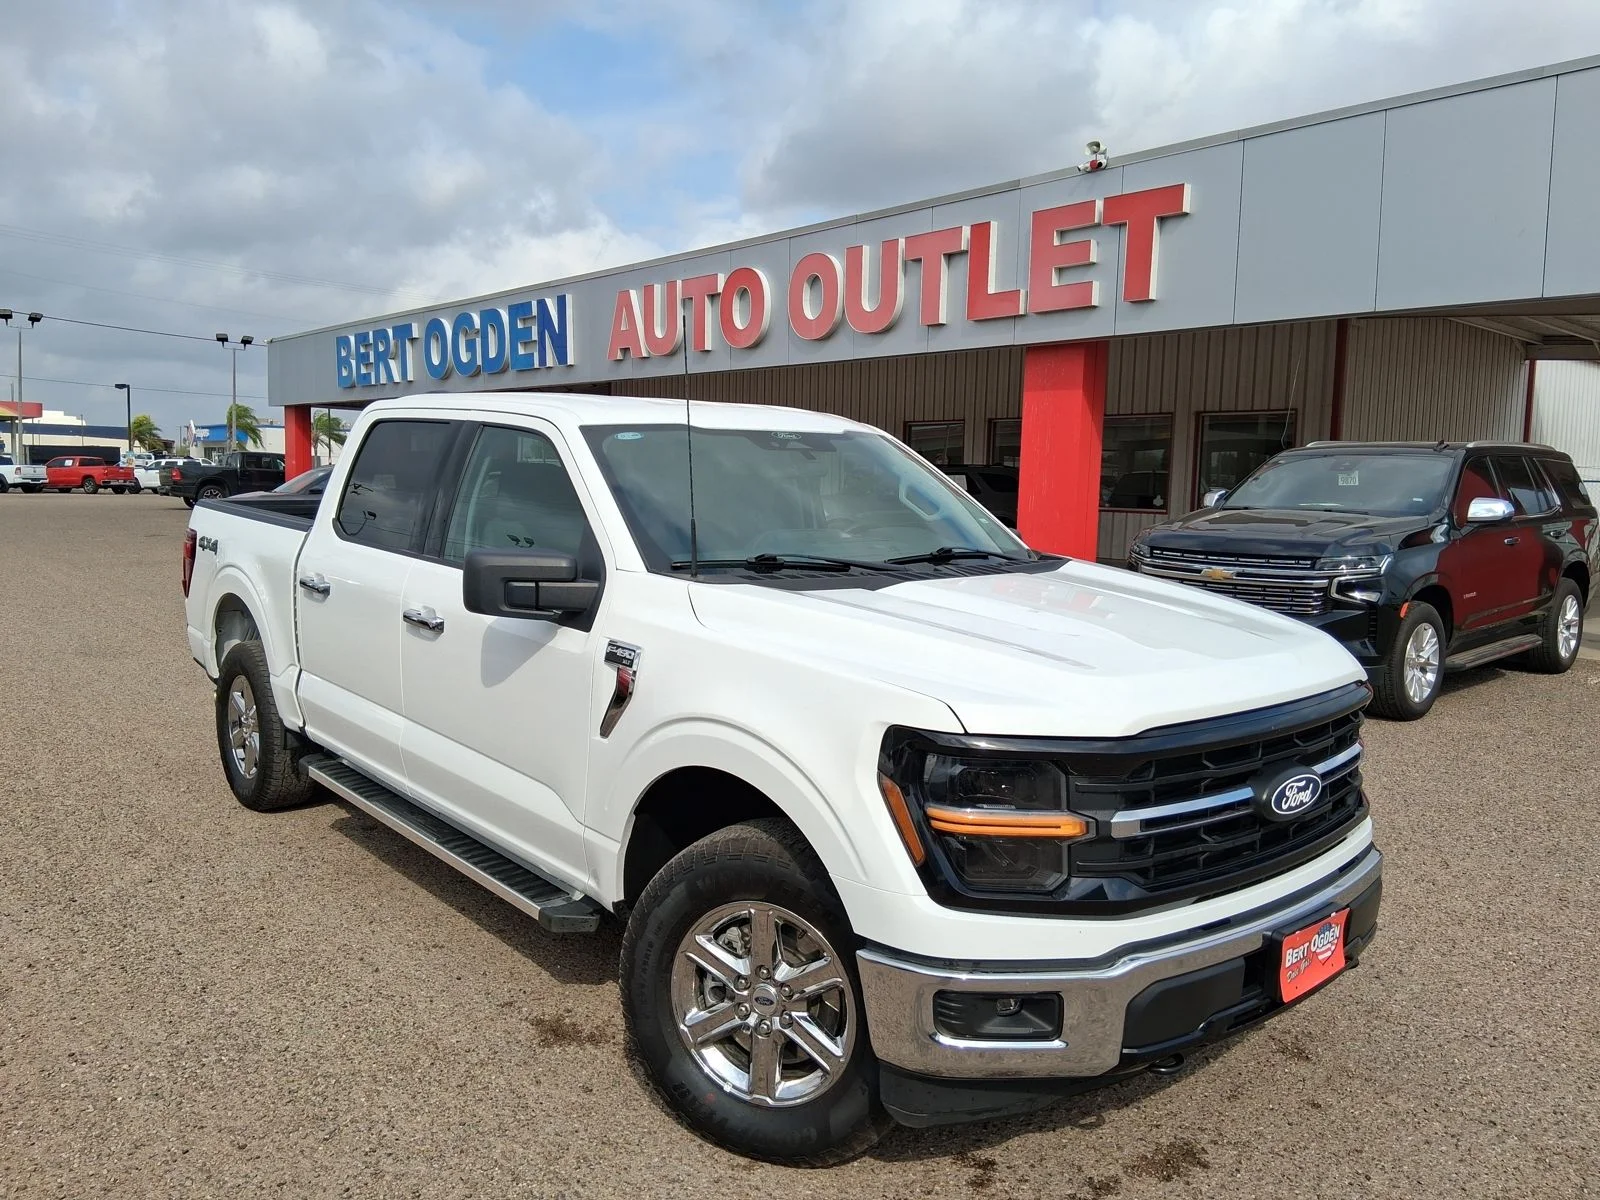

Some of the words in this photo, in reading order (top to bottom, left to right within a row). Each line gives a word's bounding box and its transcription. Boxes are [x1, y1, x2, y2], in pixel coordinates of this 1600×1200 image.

[336, 323, 418, 388] BERT
[424, 294, 573, 380] OGDEN
[608, 267, 771, 361] AUTO
[788, 182, 1191, 341] OUTLET
[1282, 780, 1313, 810] Ford
[1285, 942, 1310, 968] BERT
[1310, 923, 1341, 953] OGDEN
